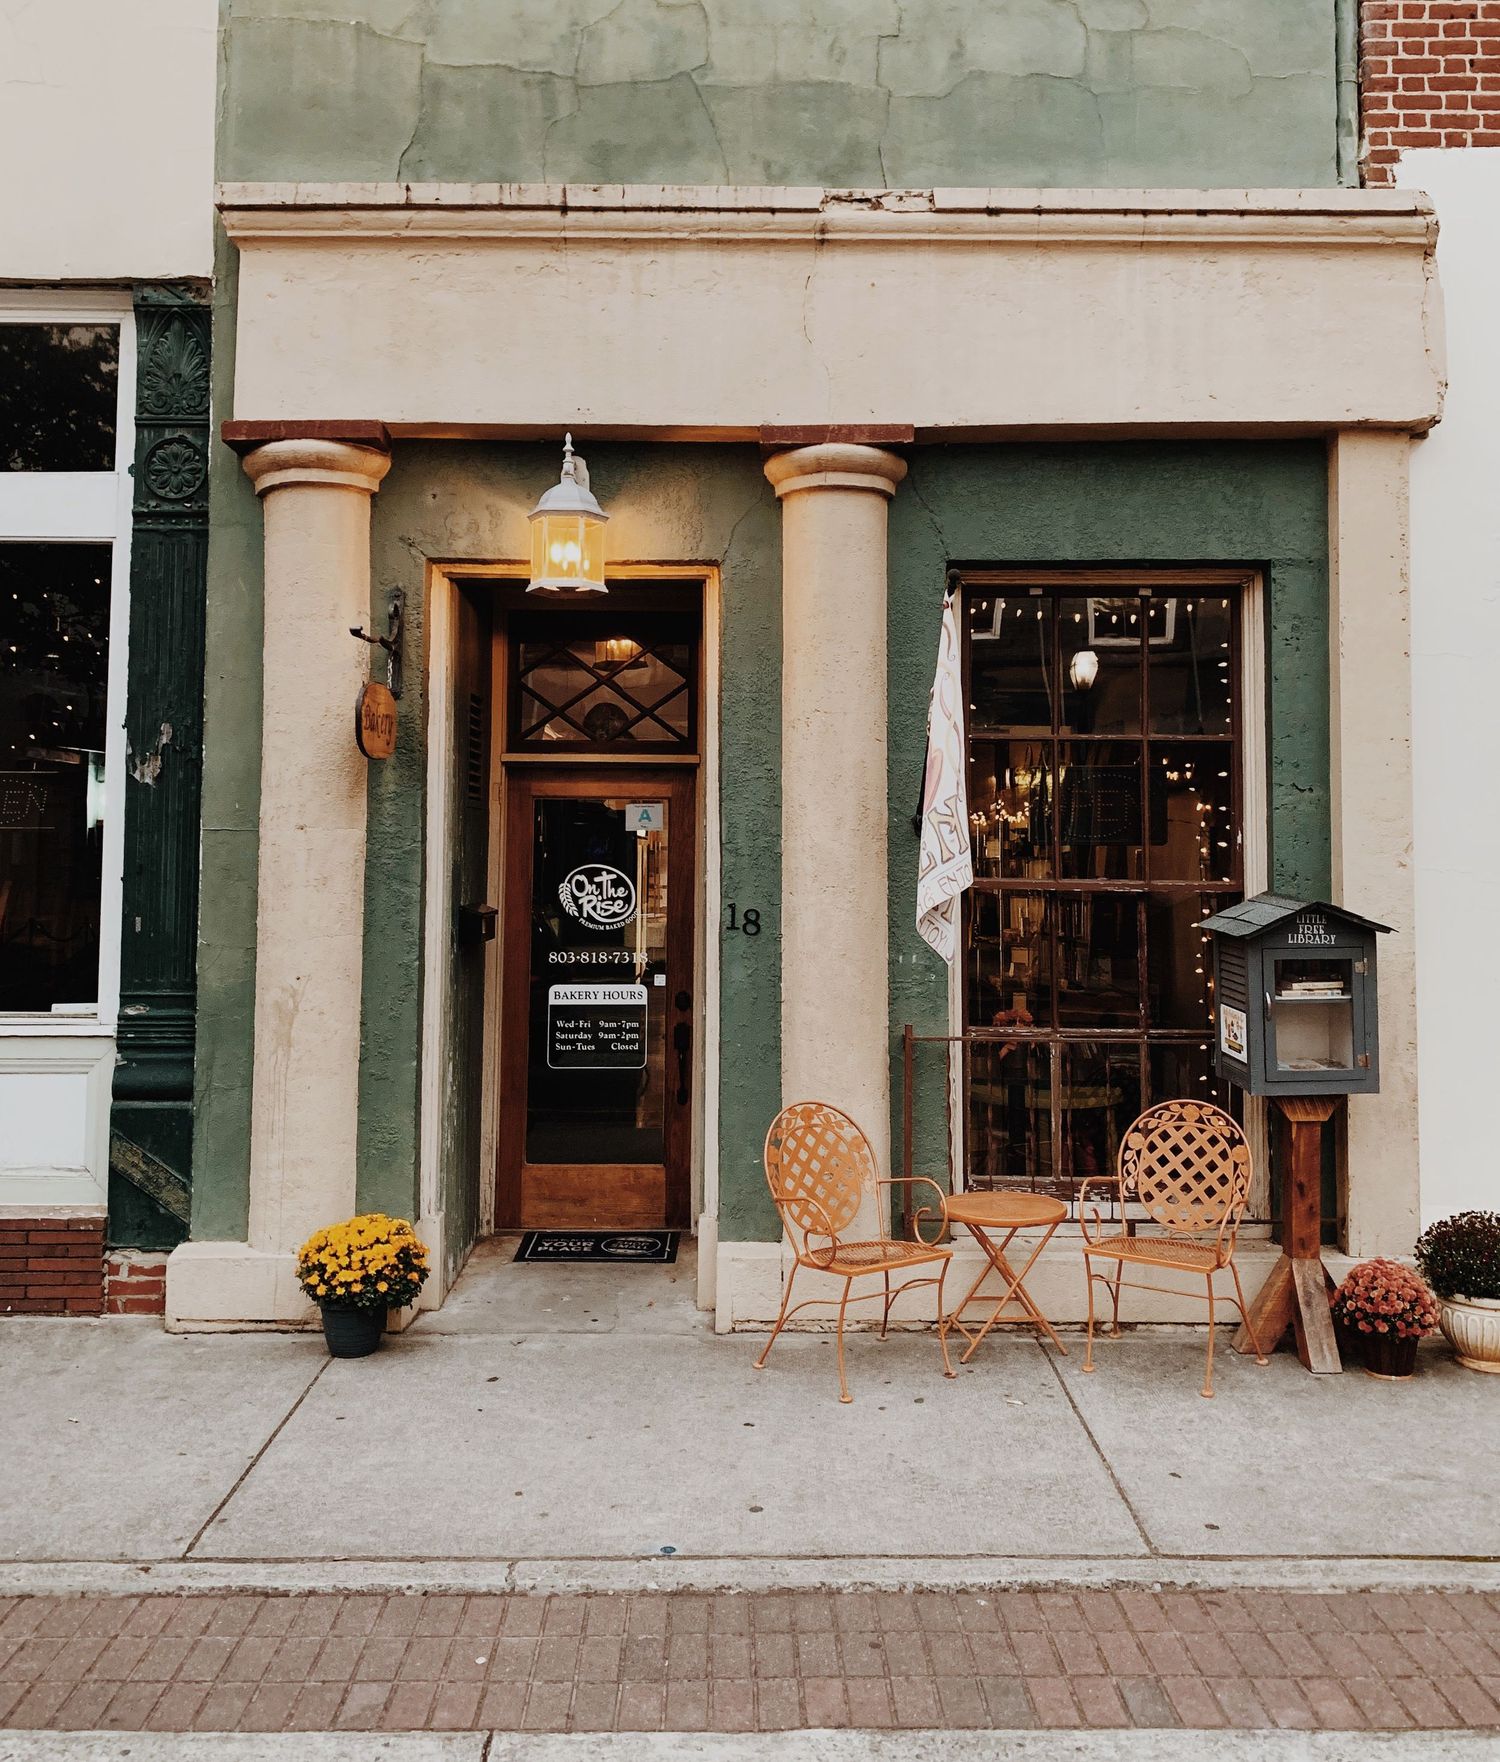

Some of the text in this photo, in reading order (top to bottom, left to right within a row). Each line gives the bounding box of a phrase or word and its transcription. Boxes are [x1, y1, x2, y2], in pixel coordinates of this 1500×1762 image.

[638, 808, 652, 822] A
[571, 871, 628, 899] On The
[578, 894, 628, 918] Rise
[578, 917, 605, 931] PREMIUM
[605, 919, 626, 931] BAKED
[726, 903, 761, 936] 18
[1296, 914, 1328, 924] LITTLE
[1299, 924, 1325, 934] FREE
[1288, 933, 1336, 945] LIBRARY
[553, 990, 643, 1000] BAKERY HOURS
[556, 1020, 639, 1030] Wed-Fri 9am-7pm
[555, 1031, 639, 1041] Saturday 9am-2pm
[555, 1042, 639, 1051] Sun-Tues Closed
